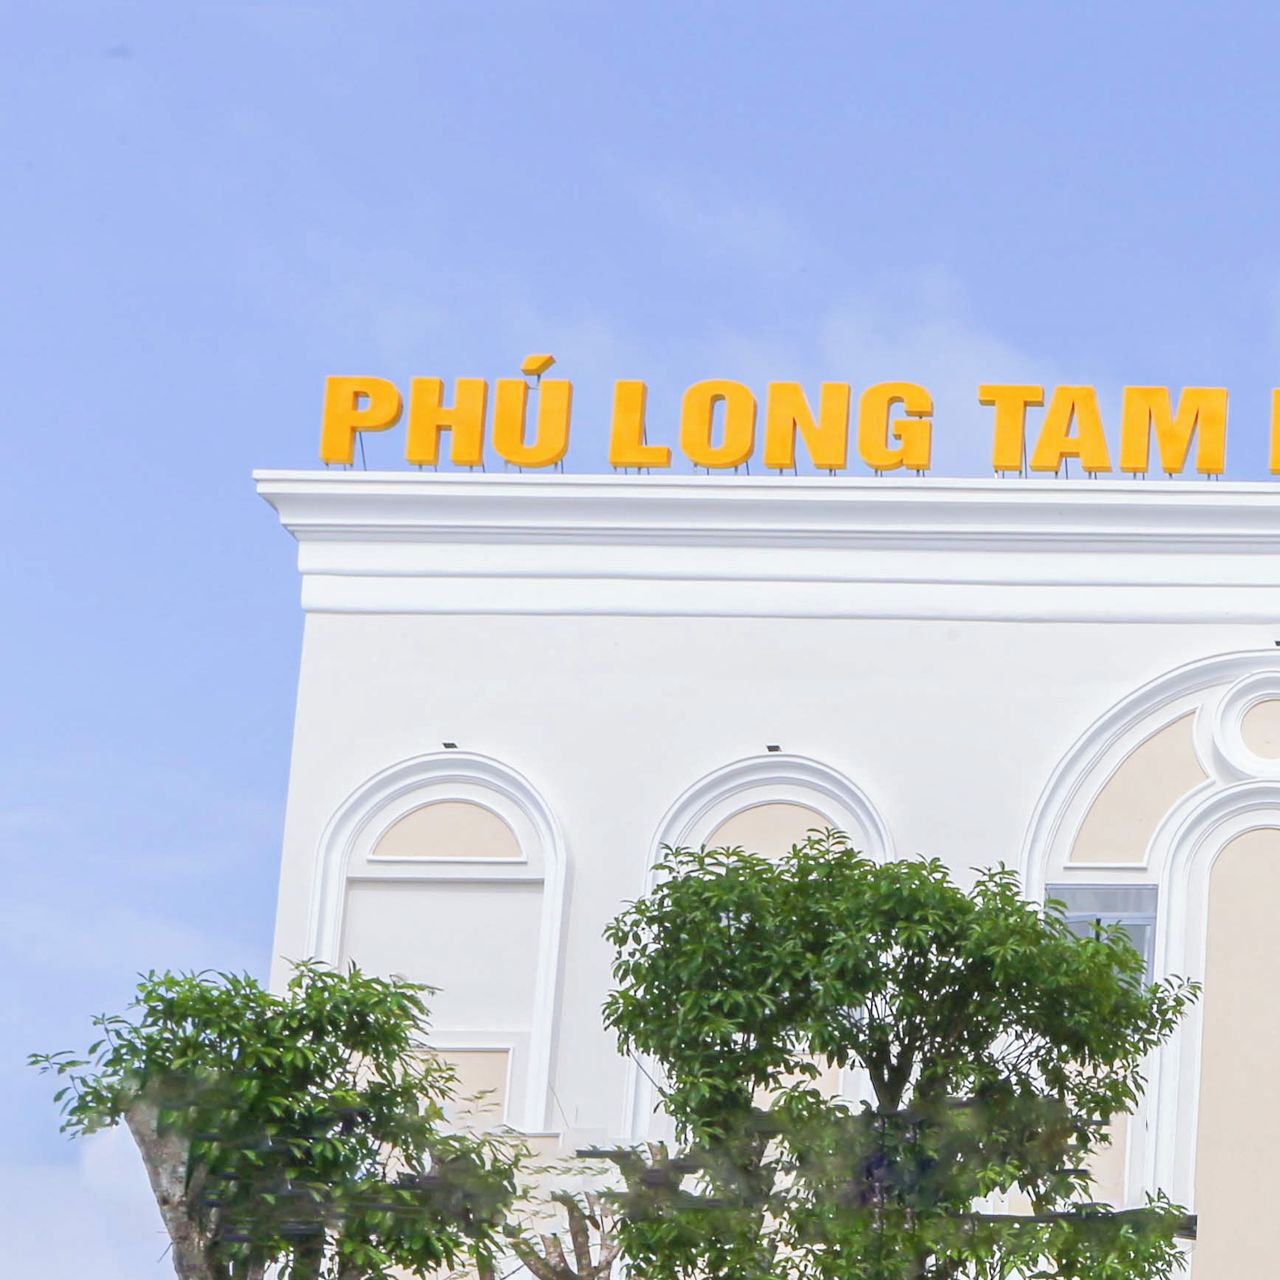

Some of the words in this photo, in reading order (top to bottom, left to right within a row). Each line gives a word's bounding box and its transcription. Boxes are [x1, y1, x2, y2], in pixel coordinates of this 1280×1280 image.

[320, 354, 573, 469] PHÚ
[608, 379, 933, 471] LONG
[979, 384, 1229, 474] TAM
